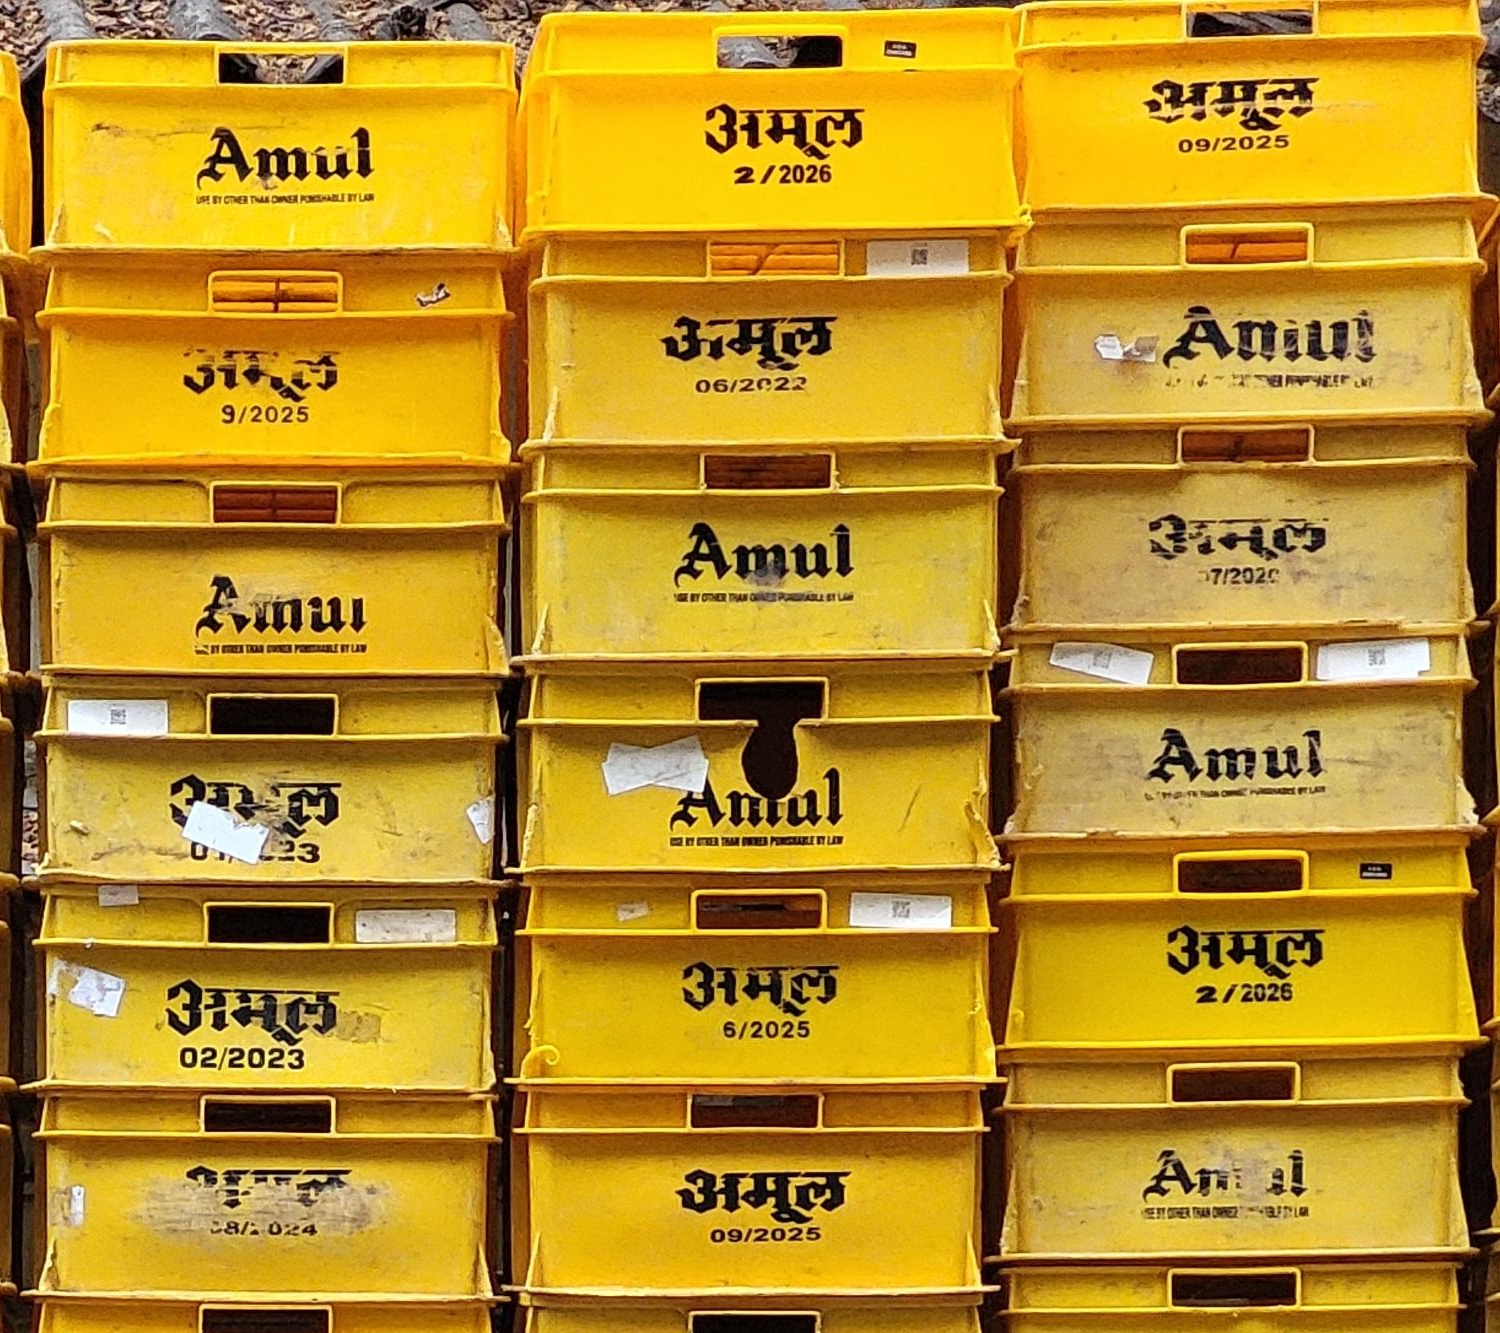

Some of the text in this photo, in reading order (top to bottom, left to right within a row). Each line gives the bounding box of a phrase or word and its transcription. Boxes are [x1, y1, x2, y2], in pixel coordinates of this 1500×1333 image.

[1143, 77, 1320, 131] अमूल
[197, 127, 374, 186] Amul
[704, 104, 865, 159] अमूल
[1178, 134, 1289, 154] 09/2025
[661, 316, 837, 370] अमूल
[221, 405, 309, 425] 9/2025
[675, 523, 853, 586] Amul
[1147, 727, 1325, 783] Amul
[1166, 925, 1325, 976] अमूल
[166, 979, 339, 1045] अमूल
[682, 961, 840, 1015] अमूल
[722, 1021, 810, 1039] 6/2025
[179, 1046, 305, 1070] 02/2023
[680, 1169, 851, 1223] अमूल
[710, 1226, 821, 1243] 09/2025
